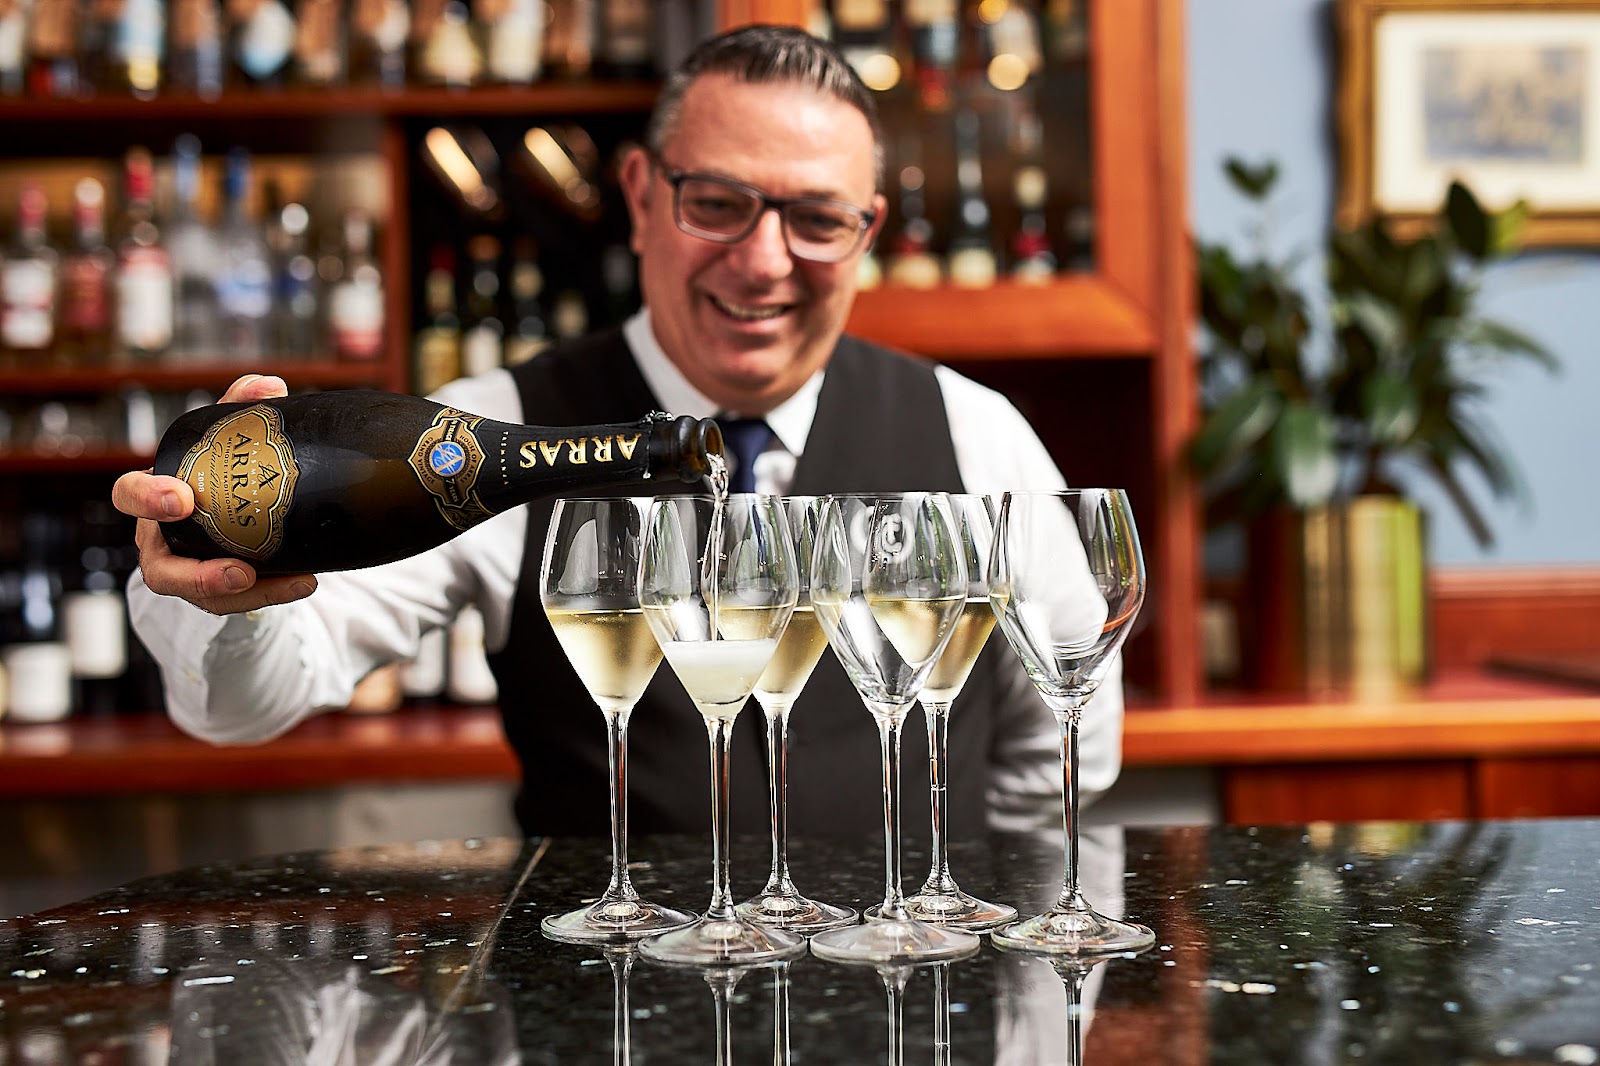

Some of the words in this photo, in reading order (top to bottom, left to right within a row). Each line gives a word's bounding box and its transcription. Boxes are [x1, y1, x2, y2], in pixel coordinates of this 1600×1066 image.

[210, 441, 223, 482] Grand
[418, 436, 434, 457] GRAND
[459, 435, 476, 452] HOUSE
[471, 453, 477, 463] OF
[500, 431, 509, 485] TASMANIA
[519, 432, 642, 469] ARRAS
[197, 471, 205, 493] 2008
[231, 432, 257, 527] ARRAS
[250, 441, 261, 514] TASMANIA
[418, 459, 435, 484] VINTAGE
[445, 477, 455, 485] 7
